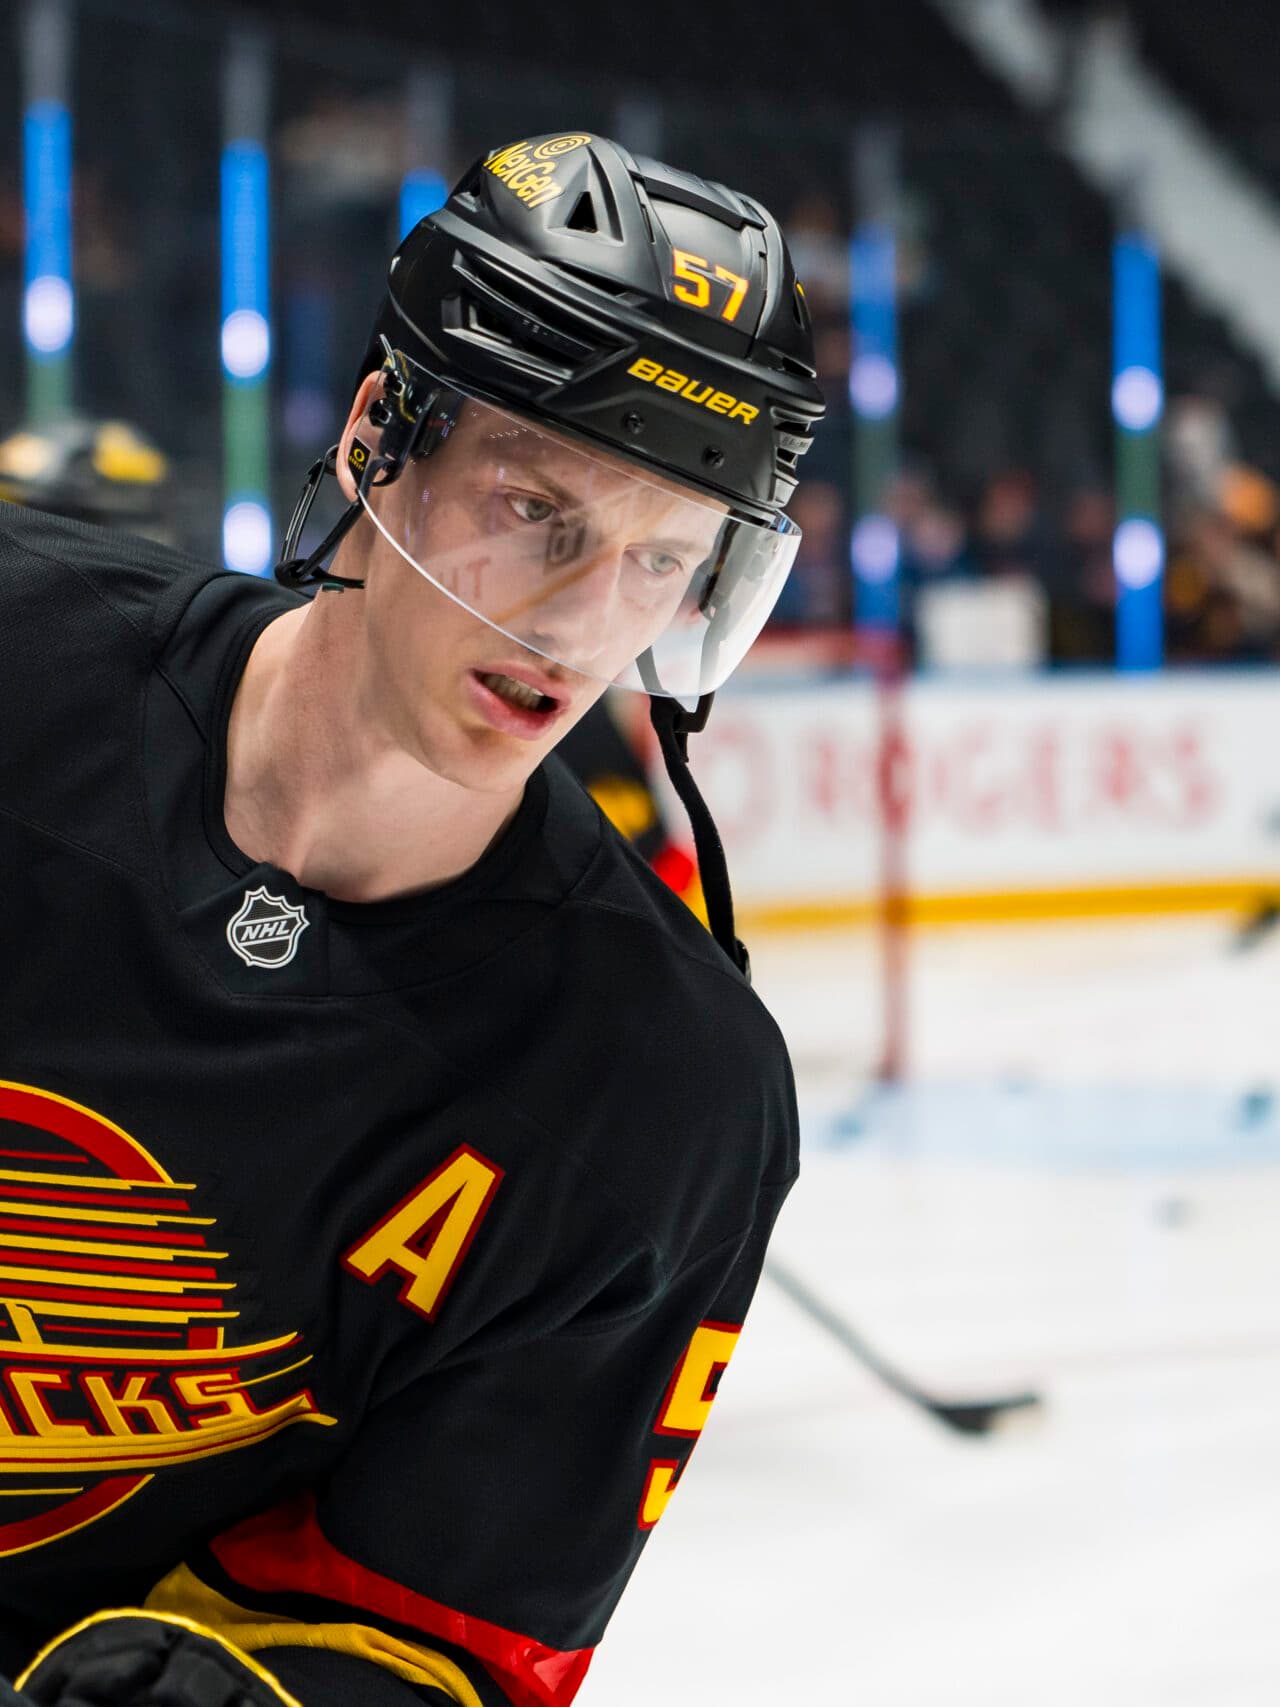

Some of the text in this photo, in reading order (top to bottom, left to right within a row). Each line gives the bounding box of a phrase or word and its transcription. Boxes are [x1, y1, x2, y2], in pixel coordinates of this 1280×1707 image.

[483, 141, 561, 208] NexGen
[672, 247, 749, 323] 57
[240, 920, 290, 941] NHL
[340, 1143, 505, 1324] A
